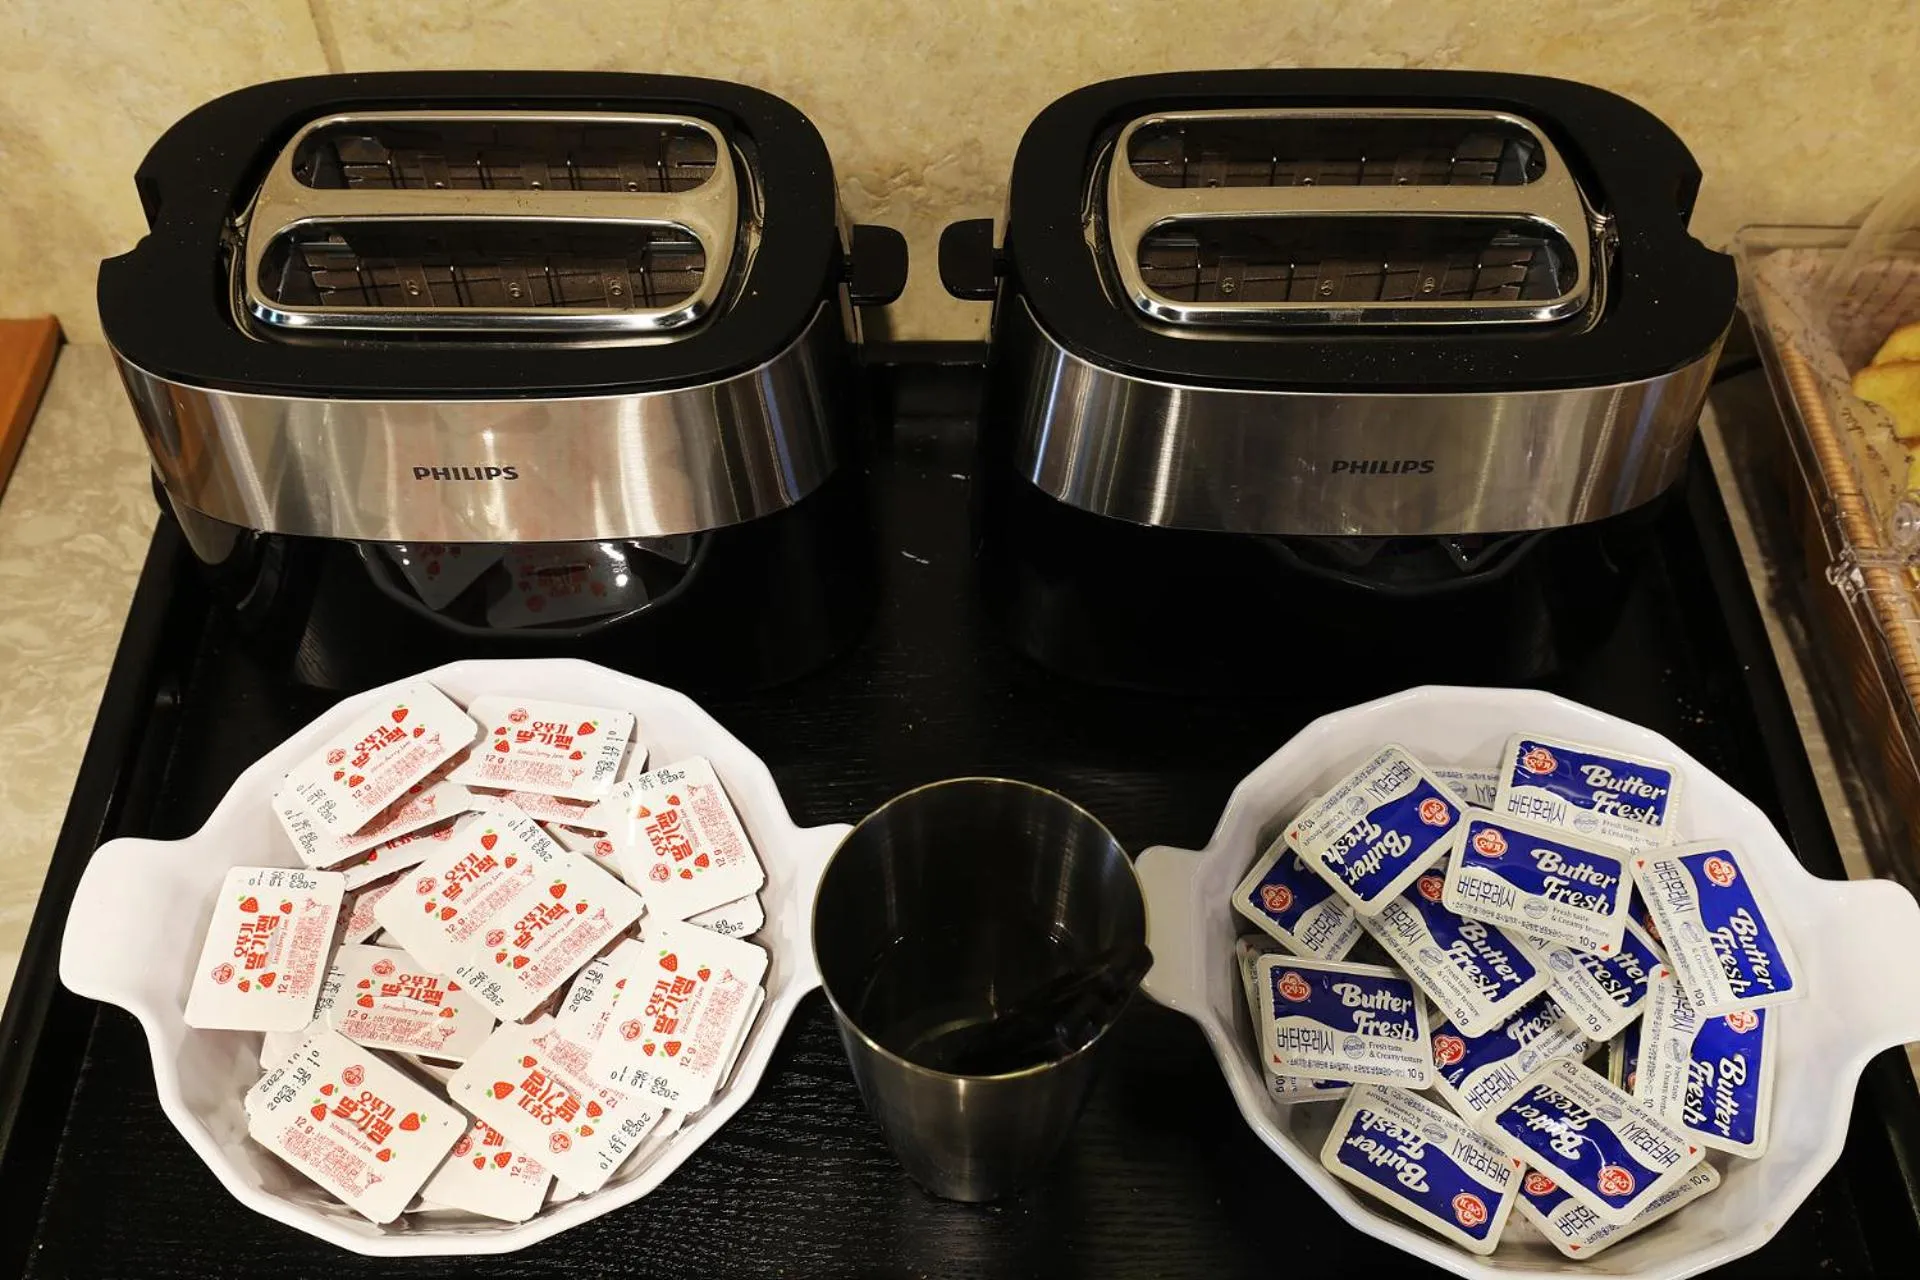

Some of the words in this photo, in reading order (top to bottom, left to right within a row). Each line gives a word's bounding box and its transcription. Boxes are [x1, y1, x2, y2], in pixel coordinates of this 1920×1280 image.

[412, 466, 519, 481] PHILIPS
[1331, 460, 1435, 474] PHILIPS
[355, 727, 389, 754] 오뚜기
[531, 721, 567, 736] 오뚜기
[1580, 764, 1667, 800] Butter
[1591, 791, 1660, 827] Fresh
[645, 822, 670, 856] 오뚜기
[1321, 816, 1382, 865] Fresh
[1349, 830, 1412, 885] Butter
[446, 853, 480, 883] 오뚜기
[1530, 848, 1617, 889] Butter
[1543, 877, 1609, 915] Fresh
[514, 903, 551, 933] 오뚜기
[235, 923, 255, 958] 오뚜기
[1457, 916, 1522, 985] Butter
[1729, 907, 1774, 992] Butter
[1449, 941, 1501, 1002] Fresh
[1612, 948, 1649, 985] tter
[1710, 927, 1752, 994] Fresh
[400, 976, 438, 992] 오뚜기
[646, 980, 671, 1020] 오뚜기
[1332, 982, 1412, 1013] Butter
[1352, 1010, 1416, 1041] Fresh
[1507, 1000, 1565, 1050] Fresh
[357, 1091, 394, 1122] 오뚜기
[519, 1096, 557, 1125] 오뚜기
[1534, 1083, 1592, 1131] Fresh
[1682, 1061, 1715, 1126] Fresh
[1713, 1054, 1746, 1137] Butter
[1361, 1109, 1426, 1161] Fresh
[1511, 1103, 1581, 1160] Butter
[1347, 1136, 1430, 1193] Butter
[1555, 1205, 1600, 1236] 버터후
